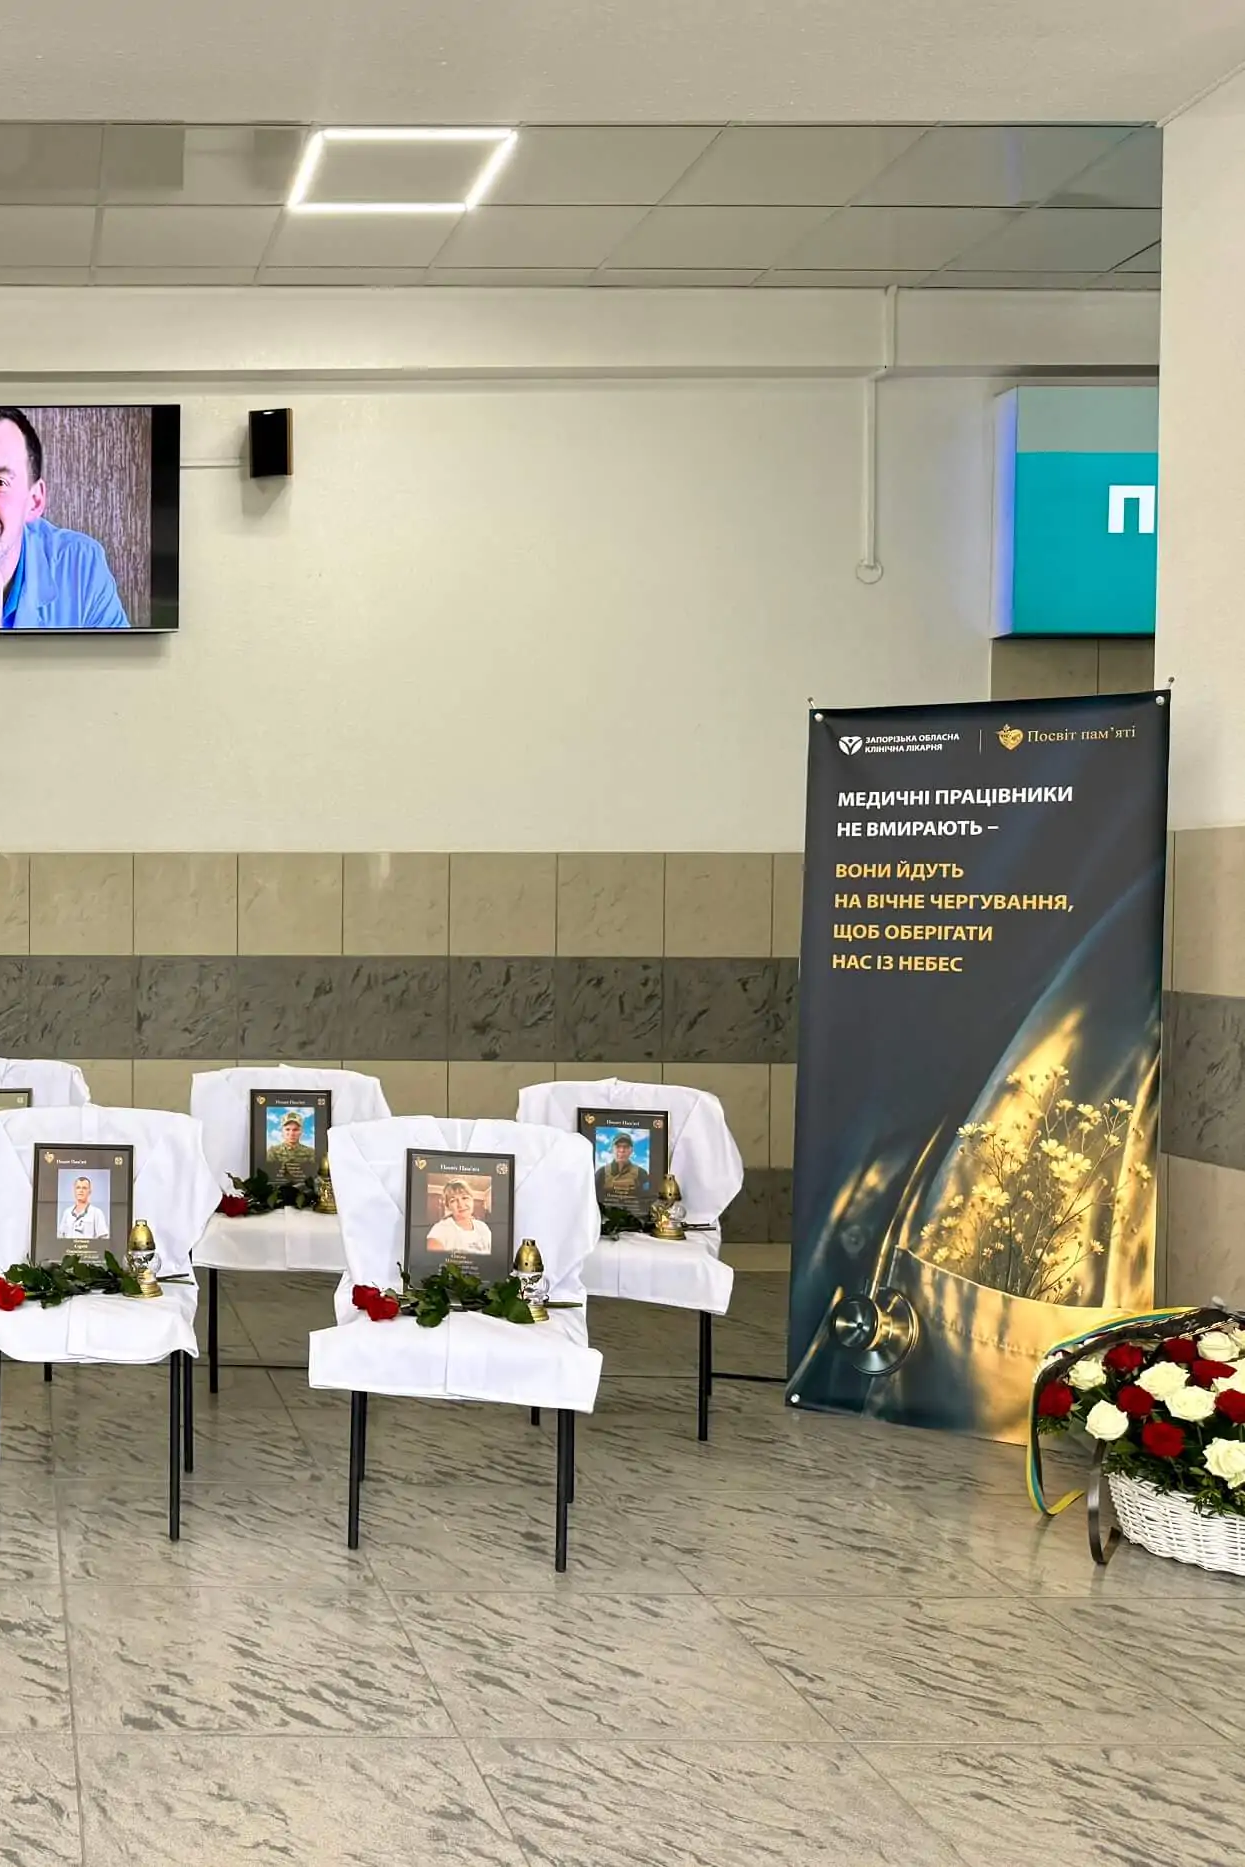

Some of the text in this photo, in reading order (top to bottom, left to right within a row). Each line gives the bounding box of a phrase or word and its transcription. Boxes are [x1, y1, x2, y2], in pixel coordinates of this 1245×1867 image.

[865, 733, 960, 744] ЗАПОРІЗЬКА ОБЛАСНА
[1028, 728, 1077, 742] Посвіт
[864, 743, 943, 753] КЛІНІЧНА ЛІКАРНЯ
[838, 786, 1073, 810] МЕДИЧНІ ПРАЦІВНИКИ
[837, 822, 862, 837] НЕ
[866, 820, 983, 837] ВМИРАЮТЬ
[835, 860, 964, 881] ВОНИ ЙДУТЬ
[834, 893, 1074, 913] НА ВІЧНЕ ЧЕРГУВАННЯ,
[833, 924, 993, 942] ЩОБ ОБЕРІГАТИ
[832, 954, 963, 972] НАС ІЗ НЕБЕС
